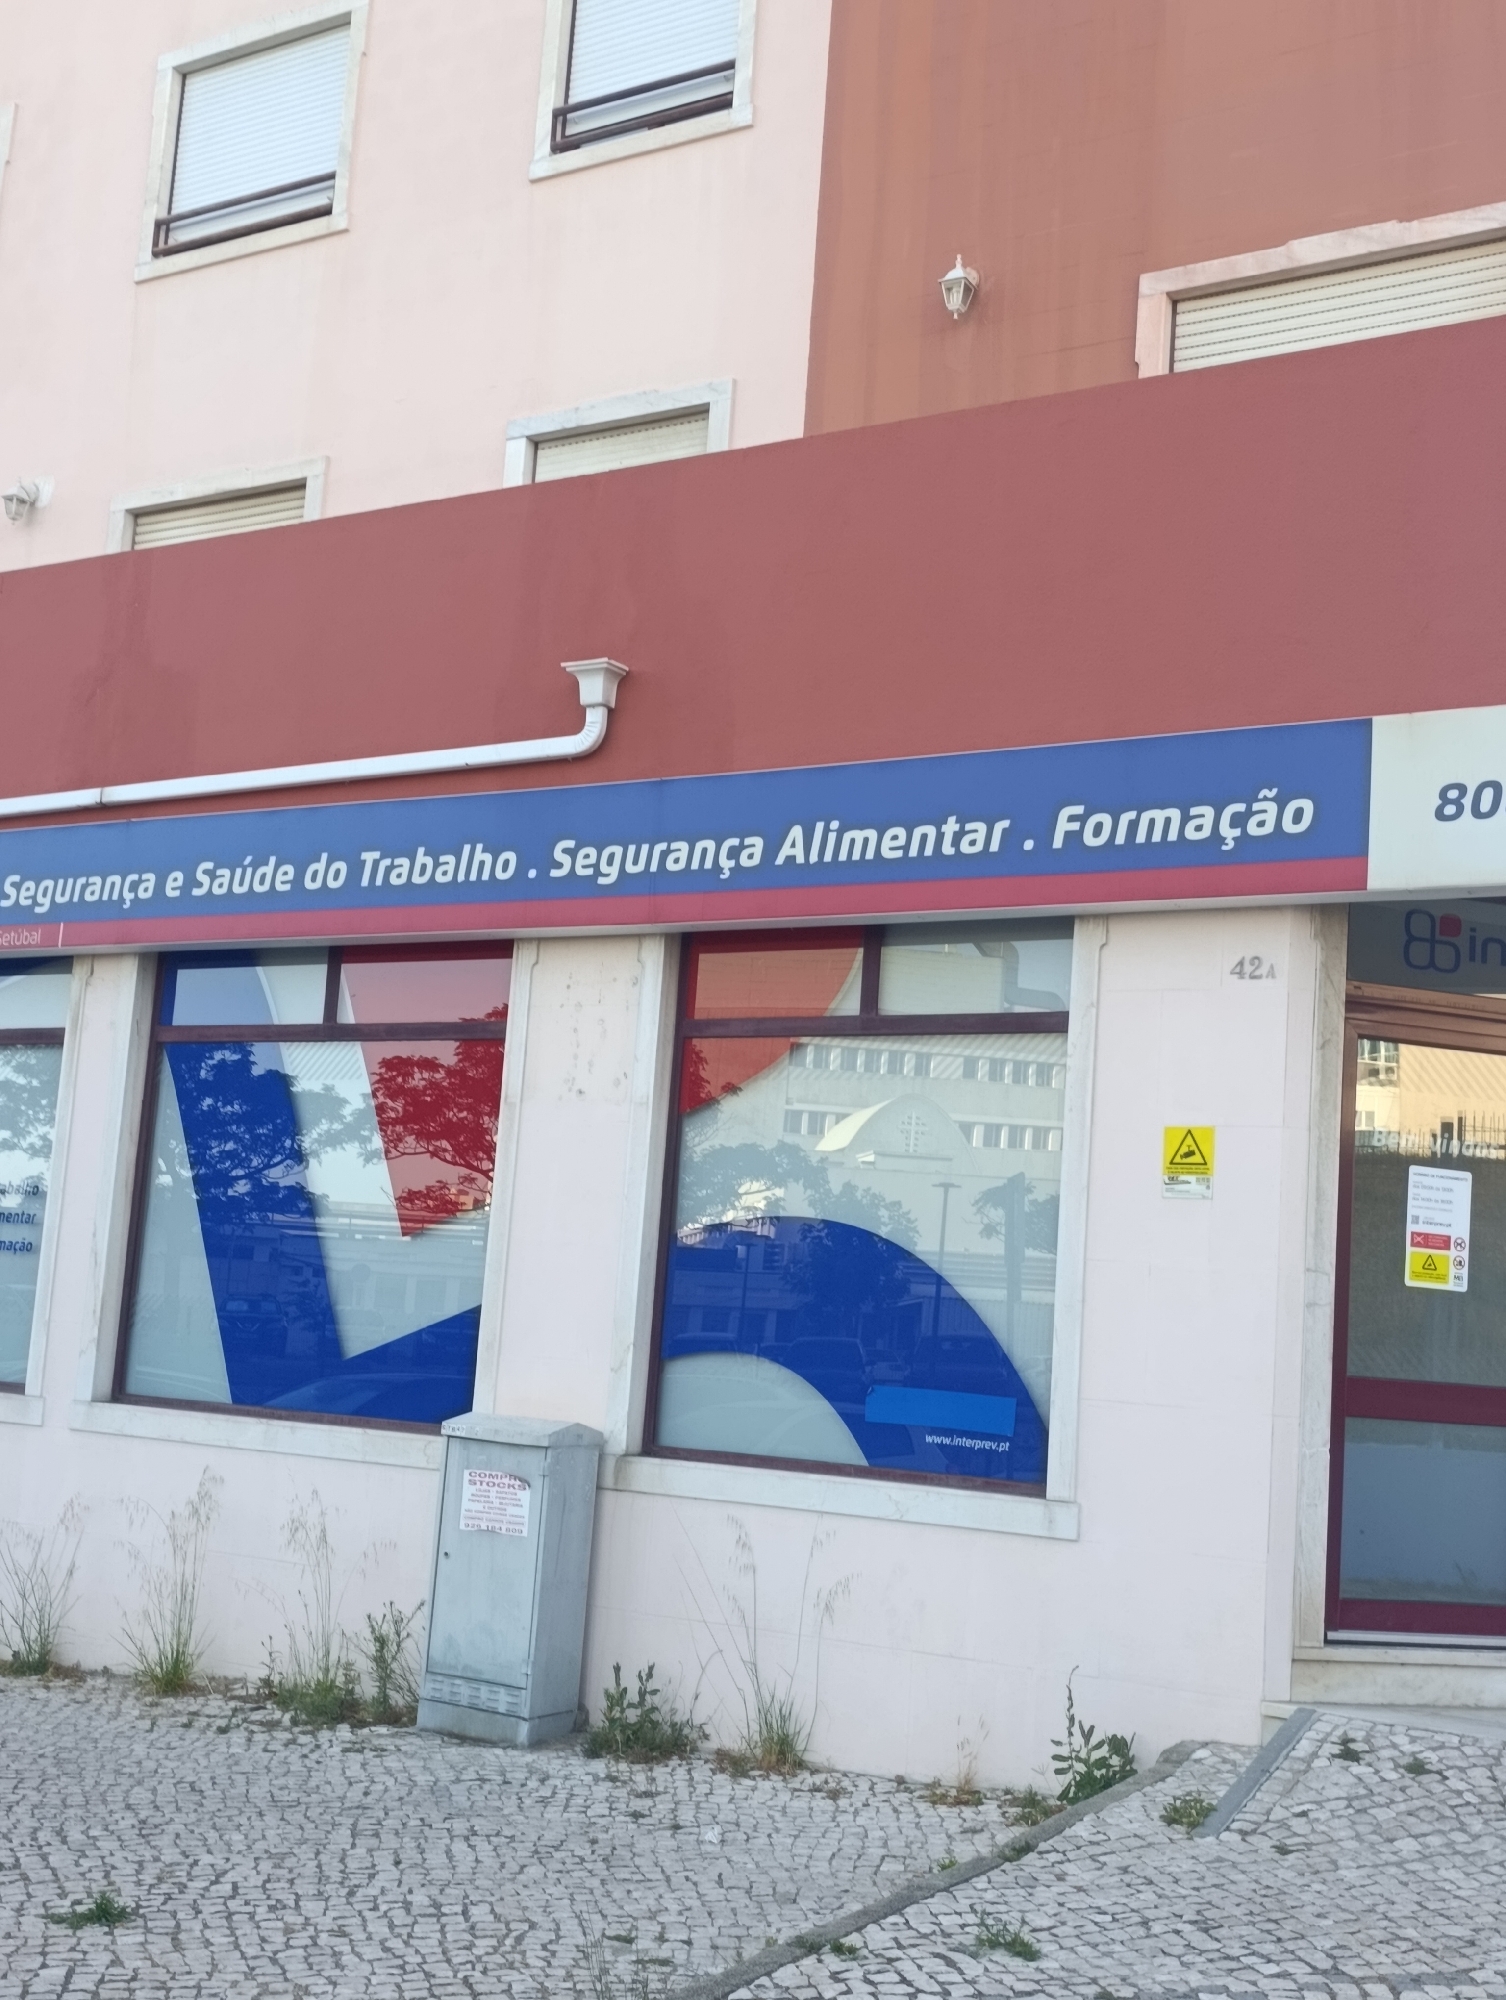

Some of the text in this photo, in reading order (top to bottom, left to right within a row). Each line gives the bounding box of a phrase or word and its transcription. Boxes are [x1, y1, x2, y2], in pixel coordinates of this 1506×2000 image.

[1434, 779, 1506, 822] 80
[0, 872, 155, 914] Segurança
[165, 870, 184, 898] e
[191, 855, 295, 897] Saúde
[303, 852, 348, 890] do
[360, 843, 517, 888] Trabalho
[549, 836, 764, 885] Segurança
[774, 814, 1011, 866] Alimentar
[1053, 787, 1314, 851] Formação
[925, 1433, 1010, 1453] www.interprev.pt
[468, 1479, 527, 1491] STOCKS
